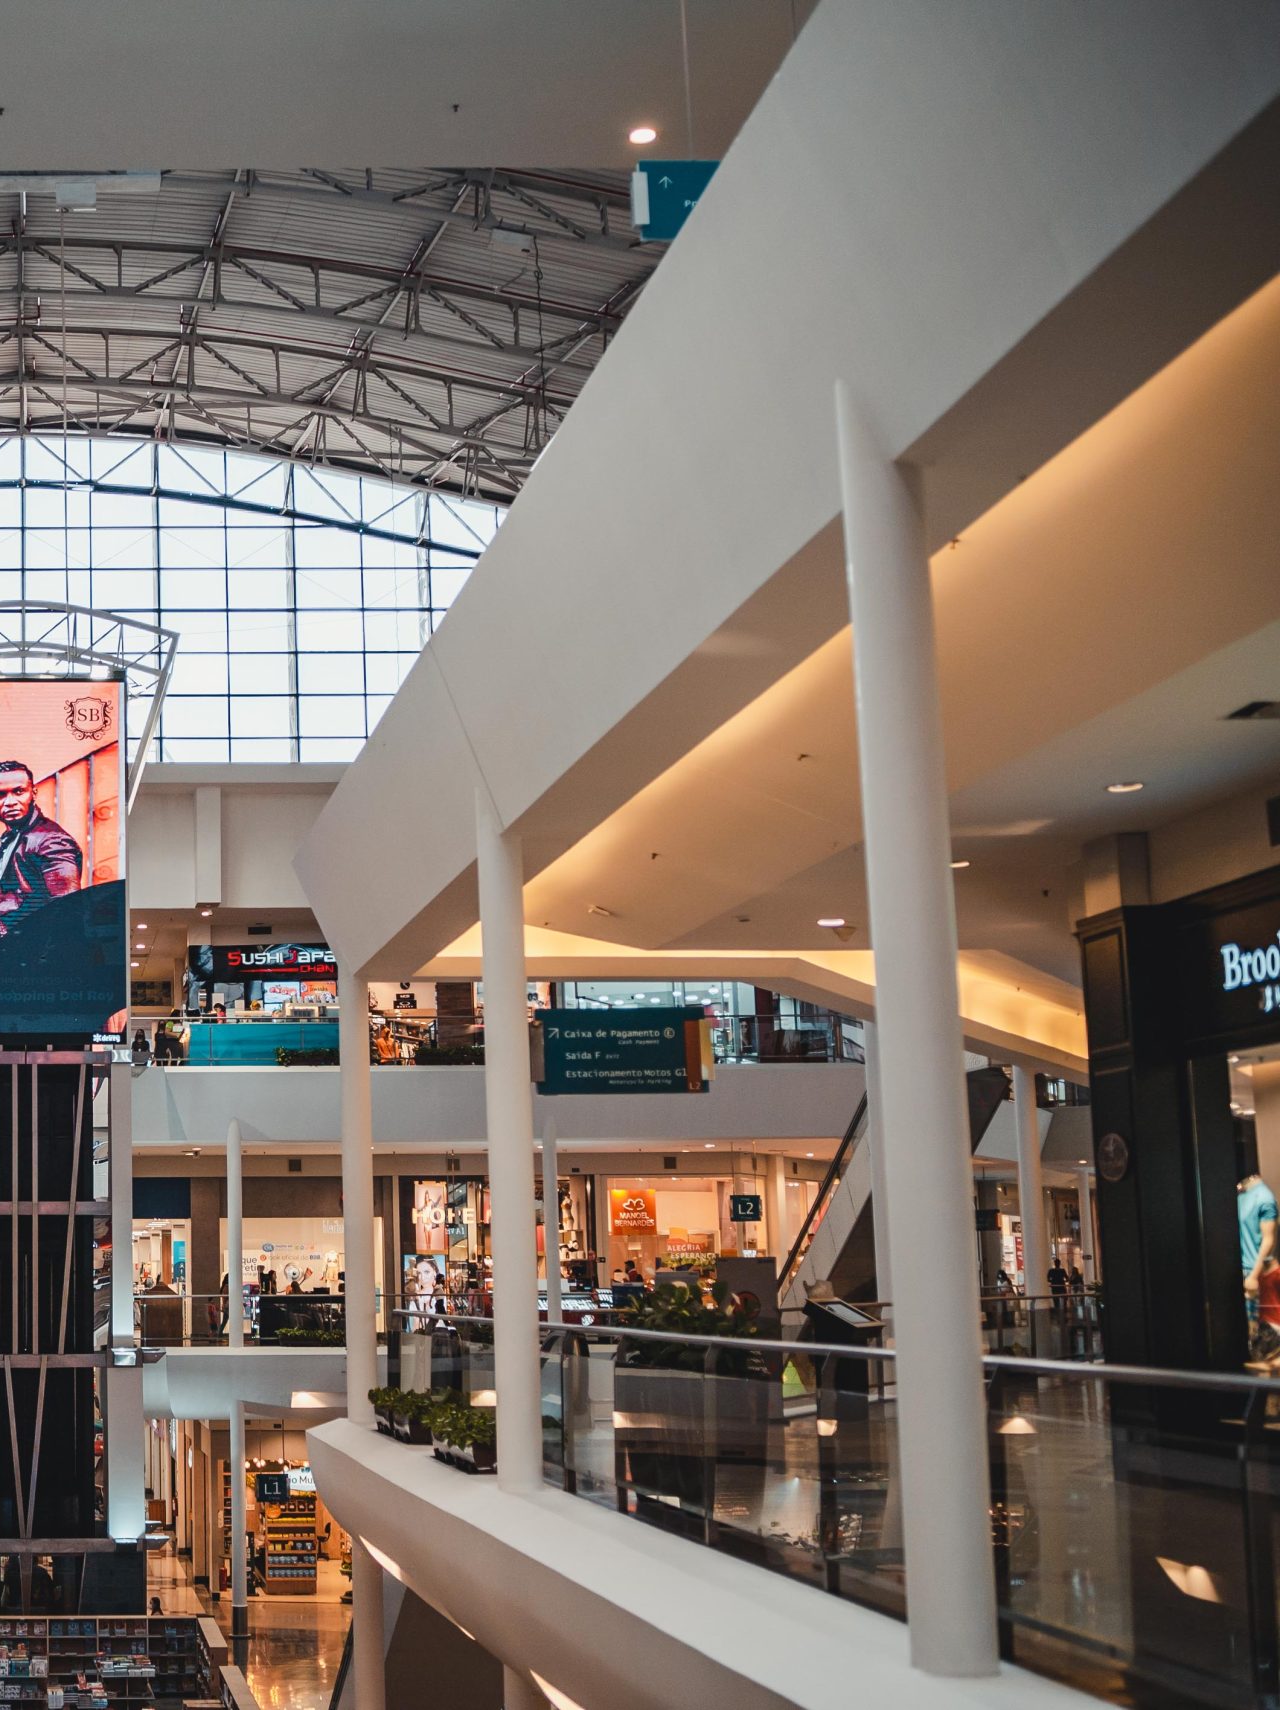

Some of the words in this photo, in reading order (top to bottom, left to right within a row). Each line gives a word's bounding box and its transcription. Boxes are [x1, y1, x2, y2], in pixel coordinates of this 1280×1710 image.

[77, 708, 100, 722] SB
[1221, 929, 1280, 991] Broo
[564, 1030, 592, 1038] Caixa
[610, 1030, 660, 1039] Pagamento
[594, 1051, 601, 1059] F
[566, 1070, 642, 1078] Estacionamento
[674, 1068, 688, 1076] G1
[689, 1082, 701, 1090] L2
[738, 1202, 754, 1215] L2
[412, 1208, 476, 1224] HOPE
[614, 1219, 655, 1227] BERNARDES
[264, 1482, 281, 1495] L1
